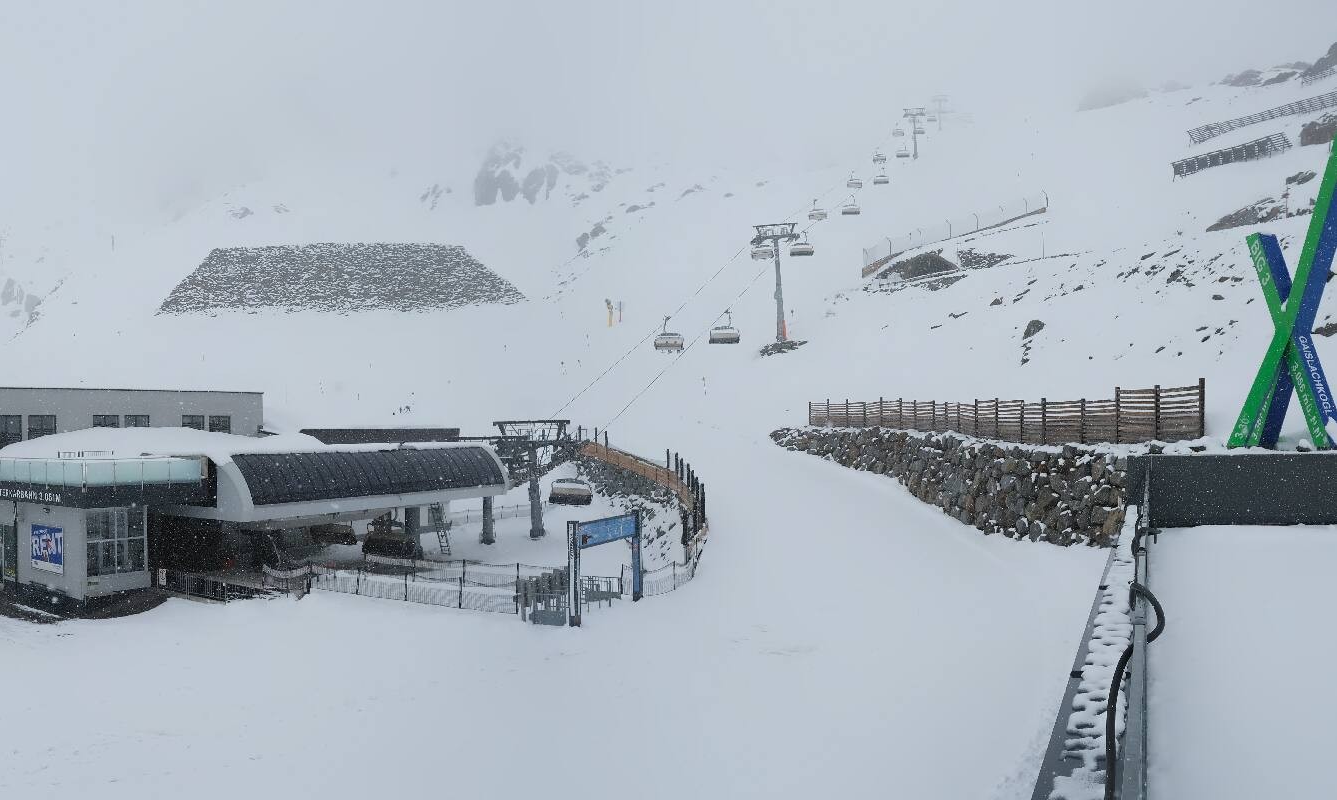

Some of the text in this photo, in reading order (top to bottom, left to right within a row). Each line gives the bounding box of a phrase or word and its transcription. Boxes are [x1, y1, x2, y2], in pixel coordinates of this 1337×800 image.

[1251, 240, 1270, 286] BIG 3
[1298, 335, 1333, 415] GAISLACHKOGL
[31, 532, 63, 556] RENT
